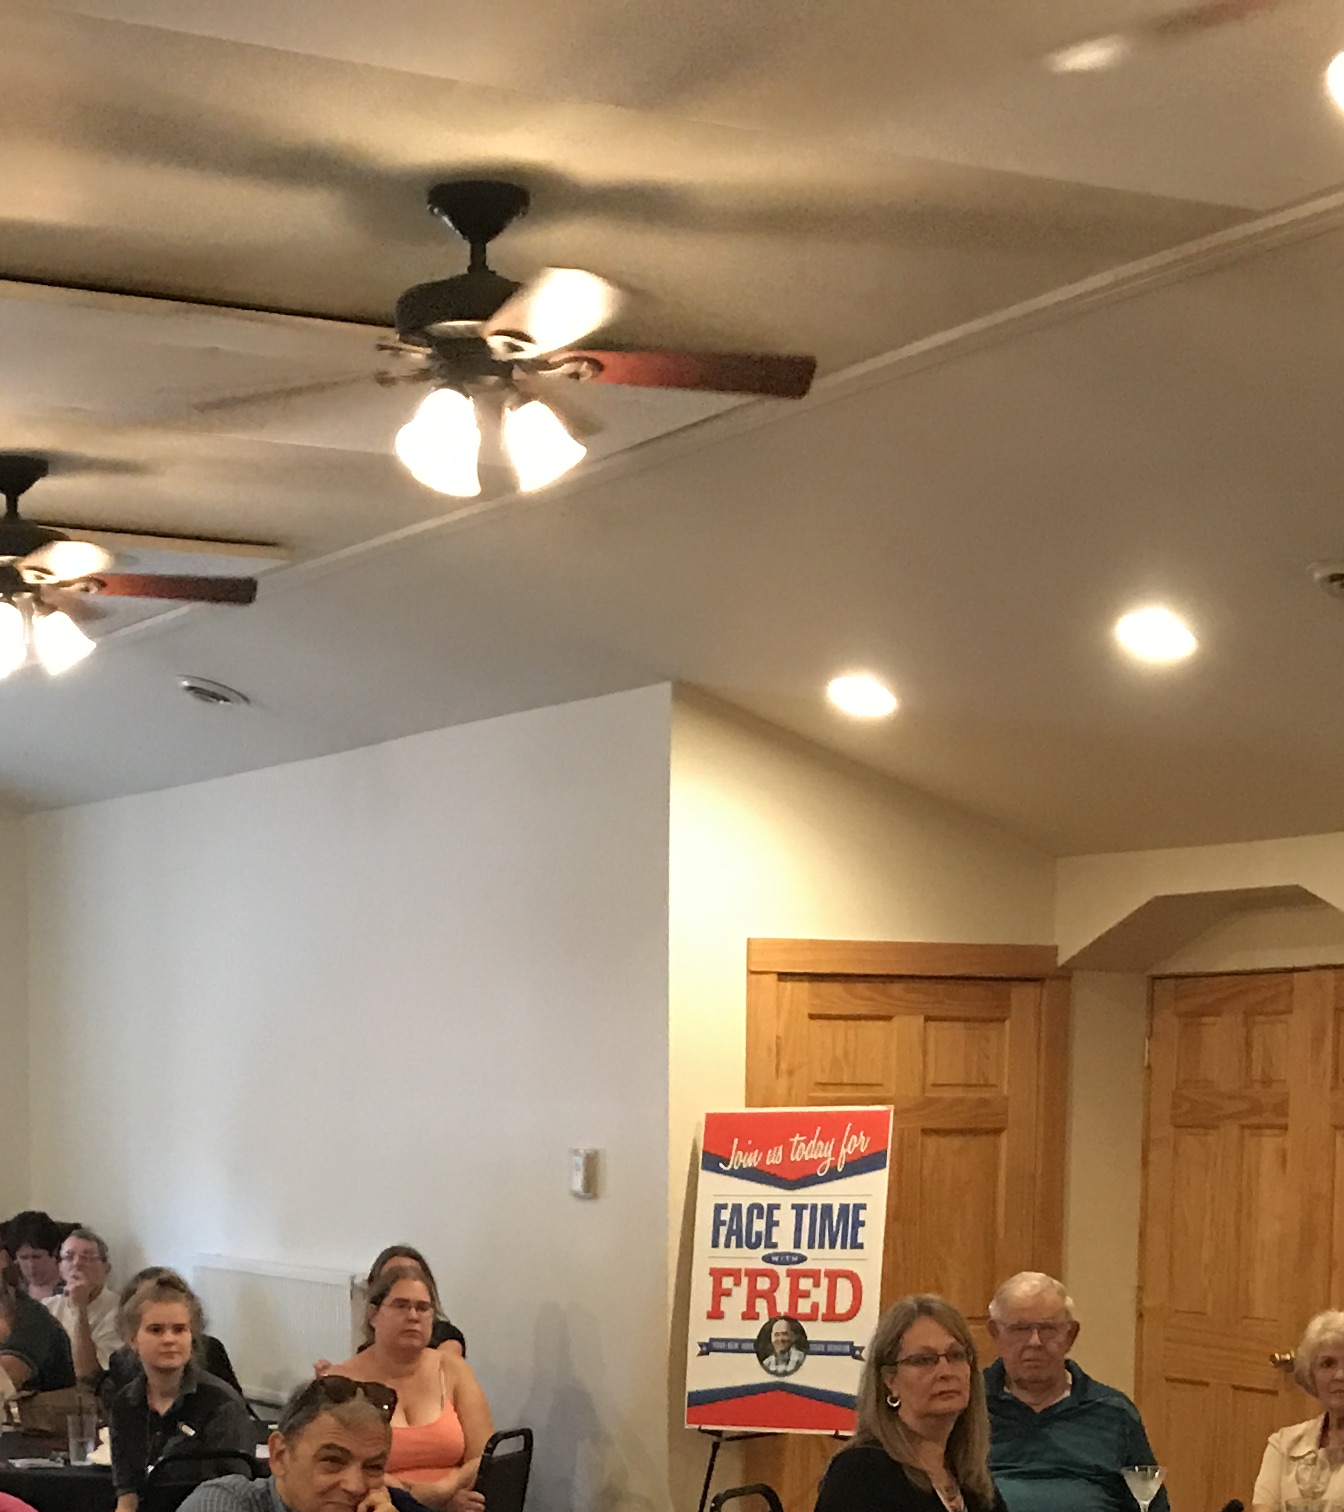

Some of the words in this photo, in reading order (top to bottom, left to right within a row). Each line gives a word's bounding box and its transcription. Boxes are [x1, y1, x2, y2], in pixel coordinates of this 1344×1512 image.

[719, 1138, 762, 1170] Join
[766, 1145, 783, 1165] us
[789, 1126, 835, 1176] today
[837, 1123, 870, 1172] for
[711, 1203, 781, 1249] FACE
[791, 1203, 867, 1249] TIME
[771, 1254, 799, 1263] WITH
[706, 1267, 863, 1322] FRED
